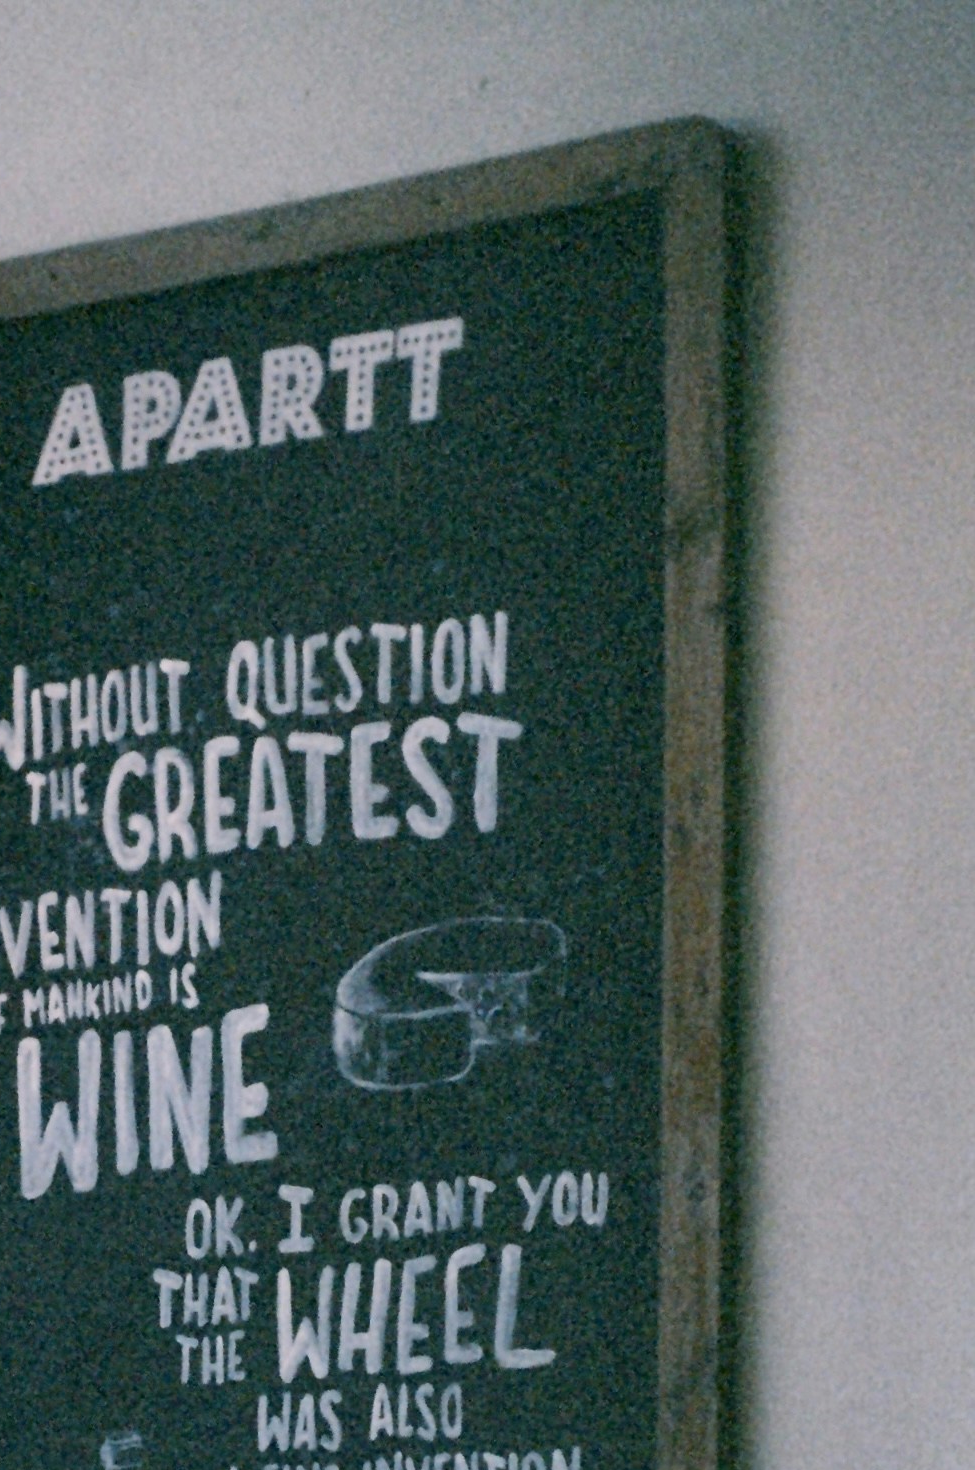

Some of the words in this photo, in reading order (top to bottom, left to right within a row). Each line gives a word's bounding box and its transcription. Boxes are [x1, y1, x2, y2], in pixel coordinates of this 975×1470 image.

[32, 316, 464, 486] APARTT
[226, 611, 509, 729] QUESTION
[27, 763, 88, 825] THE
[102, 712, 523, 871] GREATEST
[23, 969, 153, 1027] MANKIND
[169, 963, 200, 1009] IS
[16, 1003, 279, 1199] WINE
[185, 1195, 257, 1260] OK.
[277, 1184, 315, 1254] I
[339, 1175, 496, 1244] GRANT
[517, 1170, 609, 1232] YOU
[152, 1265, 260, 1329] THAT
[175, 1330, 246, 1385] THE
[276, 1243, 556, 1384] WHEEL
[256, 1389, 343, 1452] WAS
[369, 1382, 463, 1442] ALSO
